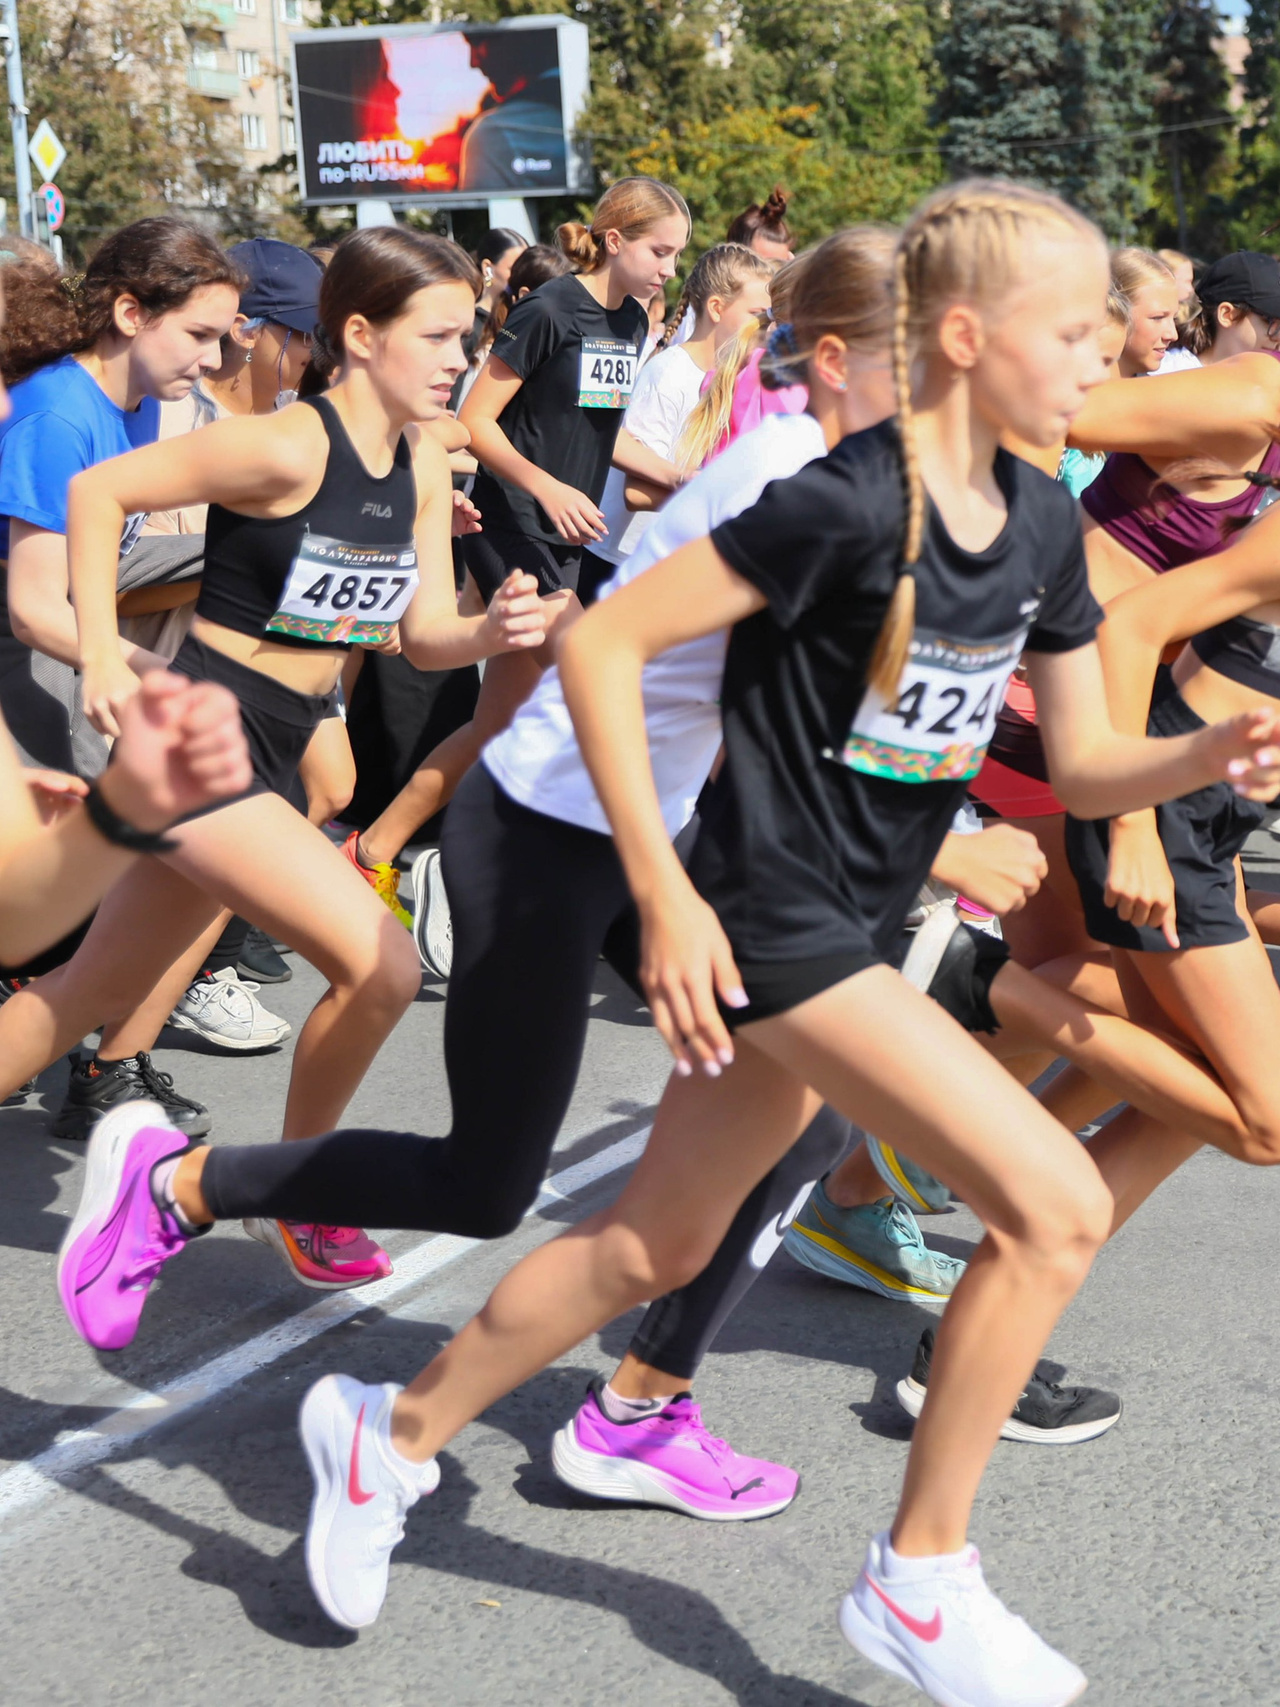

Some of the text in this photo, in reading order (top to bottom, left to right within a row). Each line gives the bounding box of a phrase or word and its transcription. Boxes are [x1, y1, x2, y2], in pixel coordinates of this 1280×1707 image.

[317, 140, 414, 164] ЛЮБИТЬ
[590, 358, 631, 386] 4281
[361, 502, 393, 518] FILA
[301, 573, 411, 612] 4857
